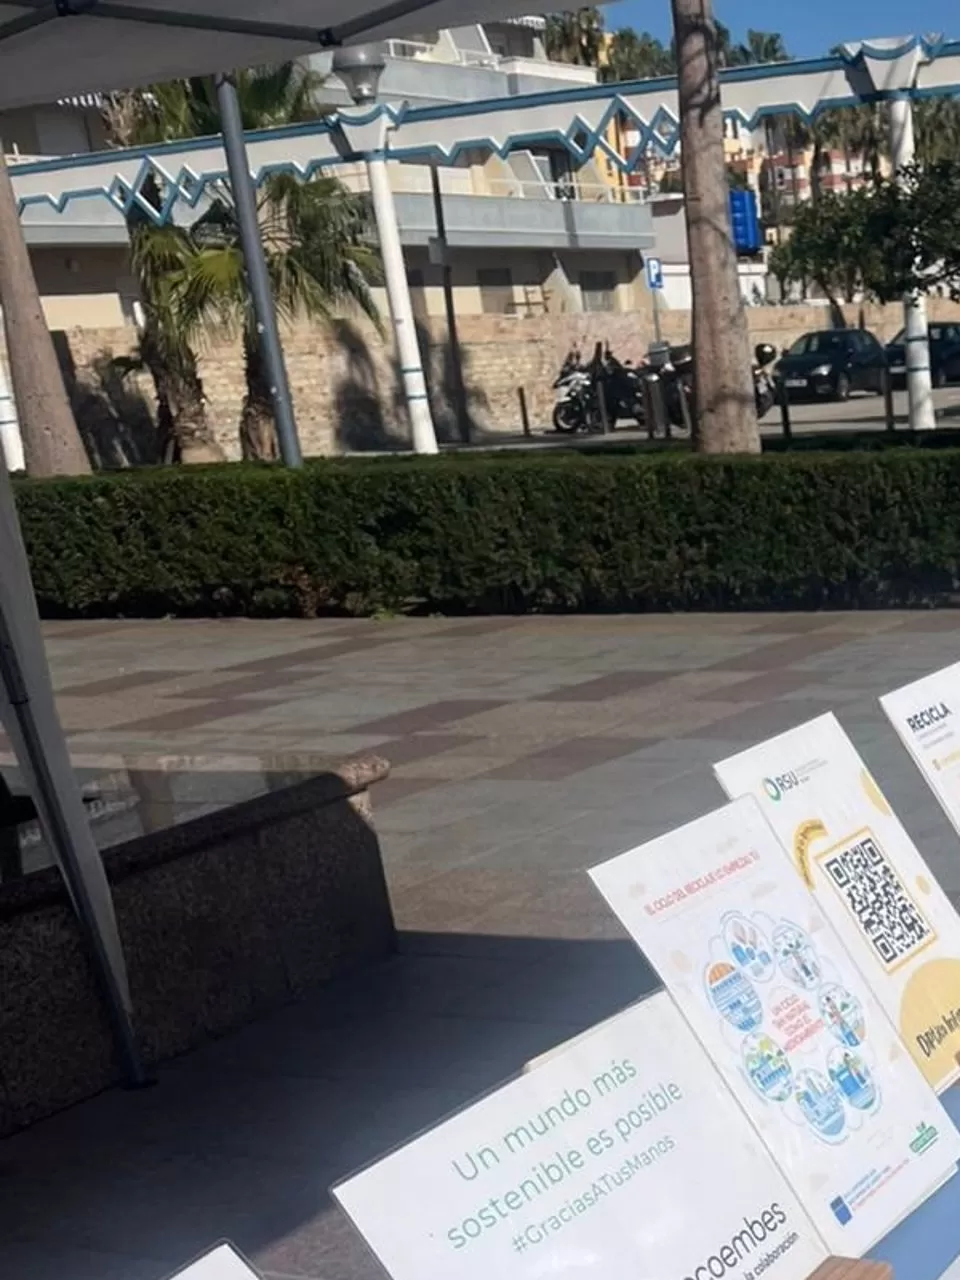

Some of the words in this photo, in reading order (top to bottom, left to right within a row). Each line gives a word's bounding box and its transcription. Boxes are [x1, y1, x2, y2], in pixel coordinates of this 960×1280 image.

[650, 260, 659, 282] P
[907, 703, 952, 733] RECICLA
[775, 770, 798, 792] RSU
[452, 1146, 500, 1181] Un
[503, 1089, 592, 1153] mundo
[593, 1058, 637, 1097] más
[448, 1150, 585, 1249] sostenible
[586, 1129, 615, 1156] es
[614, 1081, 683, 1142] posible
[512, 1135, 676, 1253] #GraciasATusManos
[753, 1232, 799, 1277] colaboración
